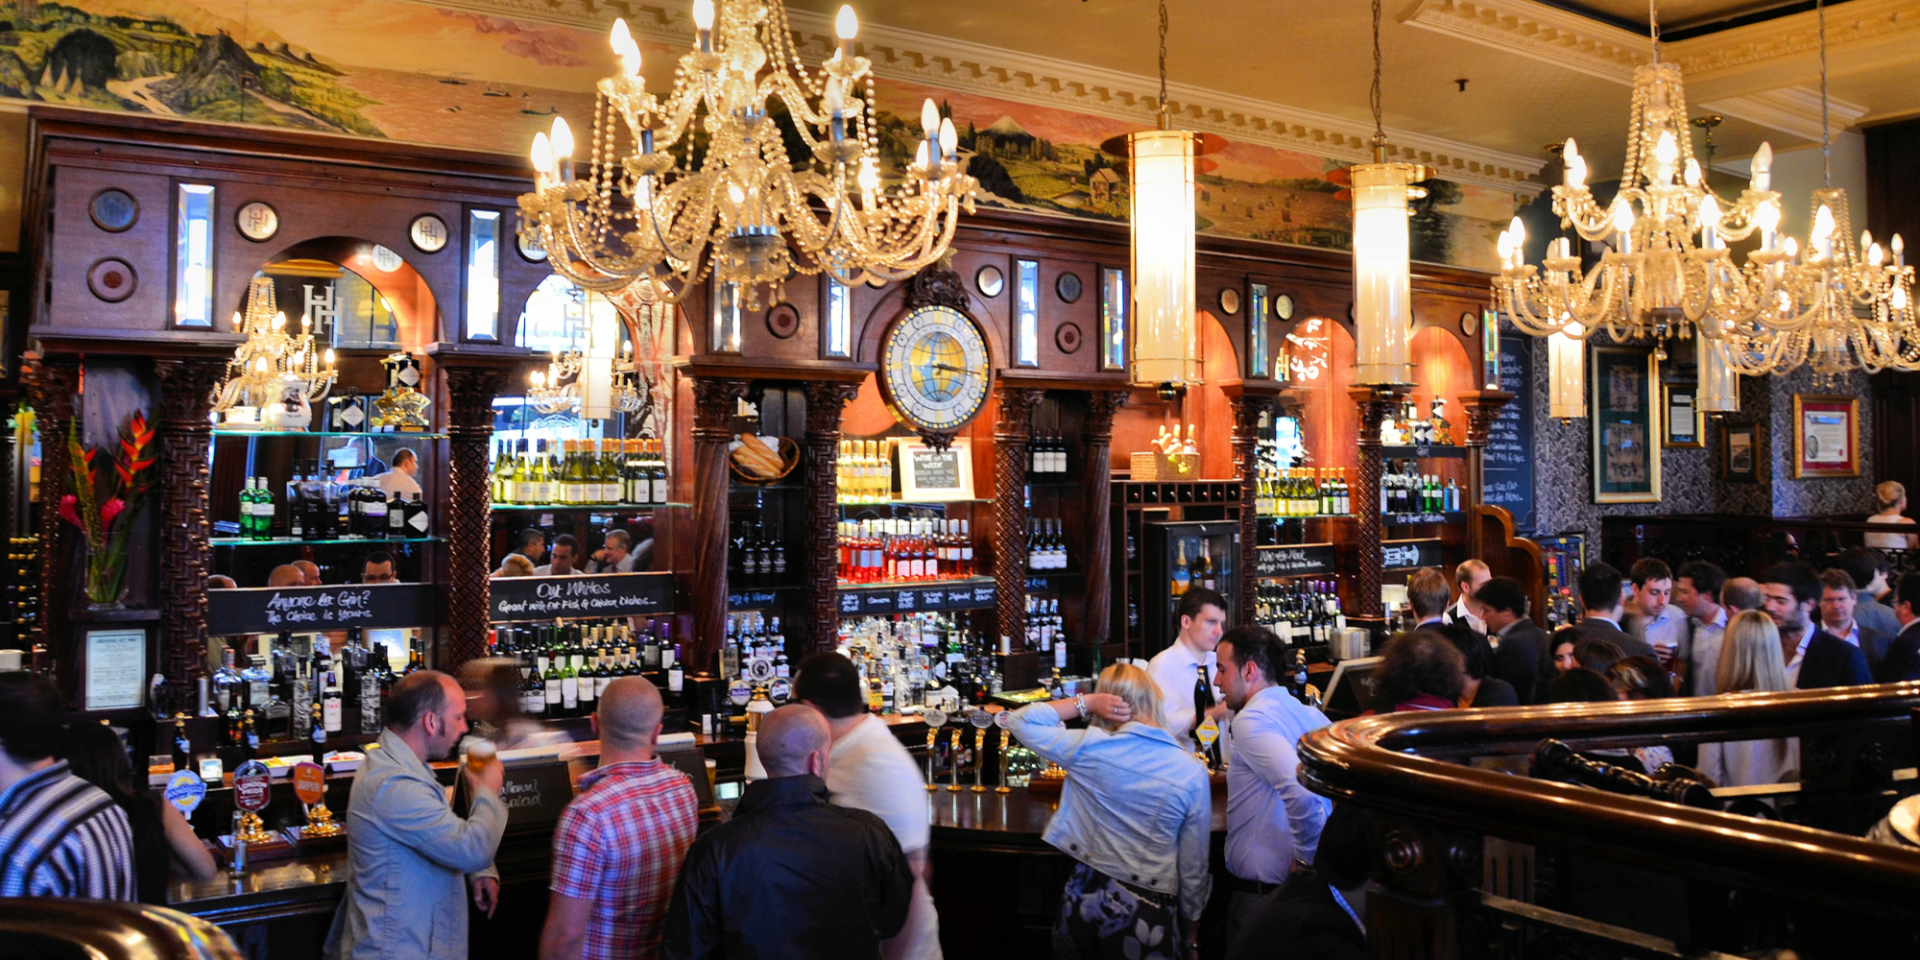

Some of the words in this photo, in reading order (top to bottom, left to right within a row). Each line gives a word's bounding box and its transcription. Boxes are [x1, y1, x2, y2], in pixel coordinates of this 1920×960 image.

[913, 454, 933, 462] WINE
[566, 581, 611, 596] Whites
[267, 592, 317, 612] Anyone
[337, 590, 371, 608] Gin?
[498, 599, 527, 614] Great
[561, 599, 580, 610] Fish
[323, 609, 334, 620] is
[237, 782, 268, 791] LONDON
